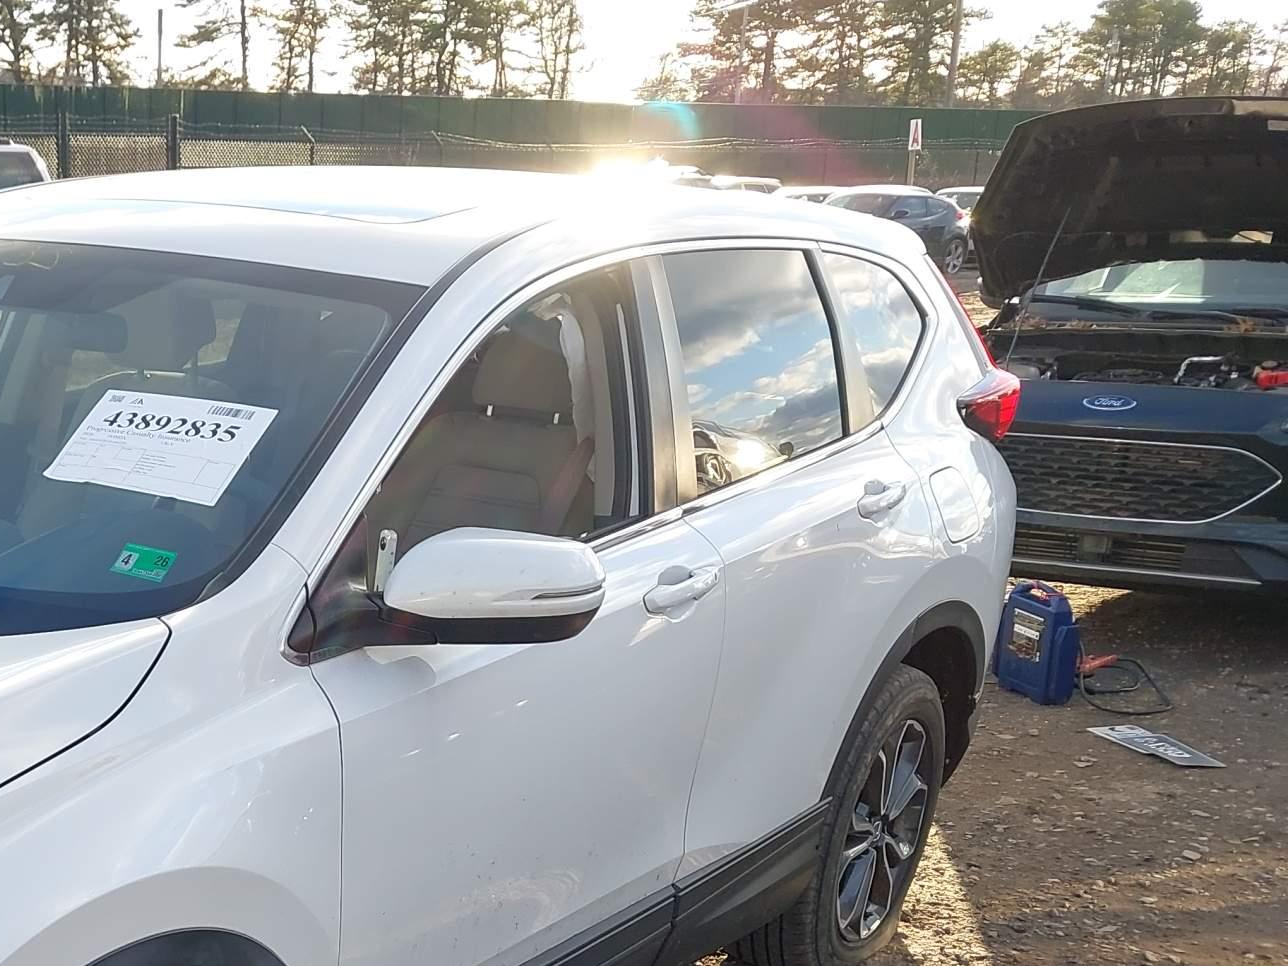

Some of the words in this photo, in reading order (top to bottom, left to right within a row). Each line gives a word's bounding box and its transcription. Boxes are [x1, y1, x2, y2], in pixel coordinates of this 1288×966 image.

[911, 119, 920, 148] A
[1094, 397, 1125, 406] Ford
[103, 410, 242, 442] 43892835
[121, 553, 133, 566] 4
[153, 555, 170, 568] 26
